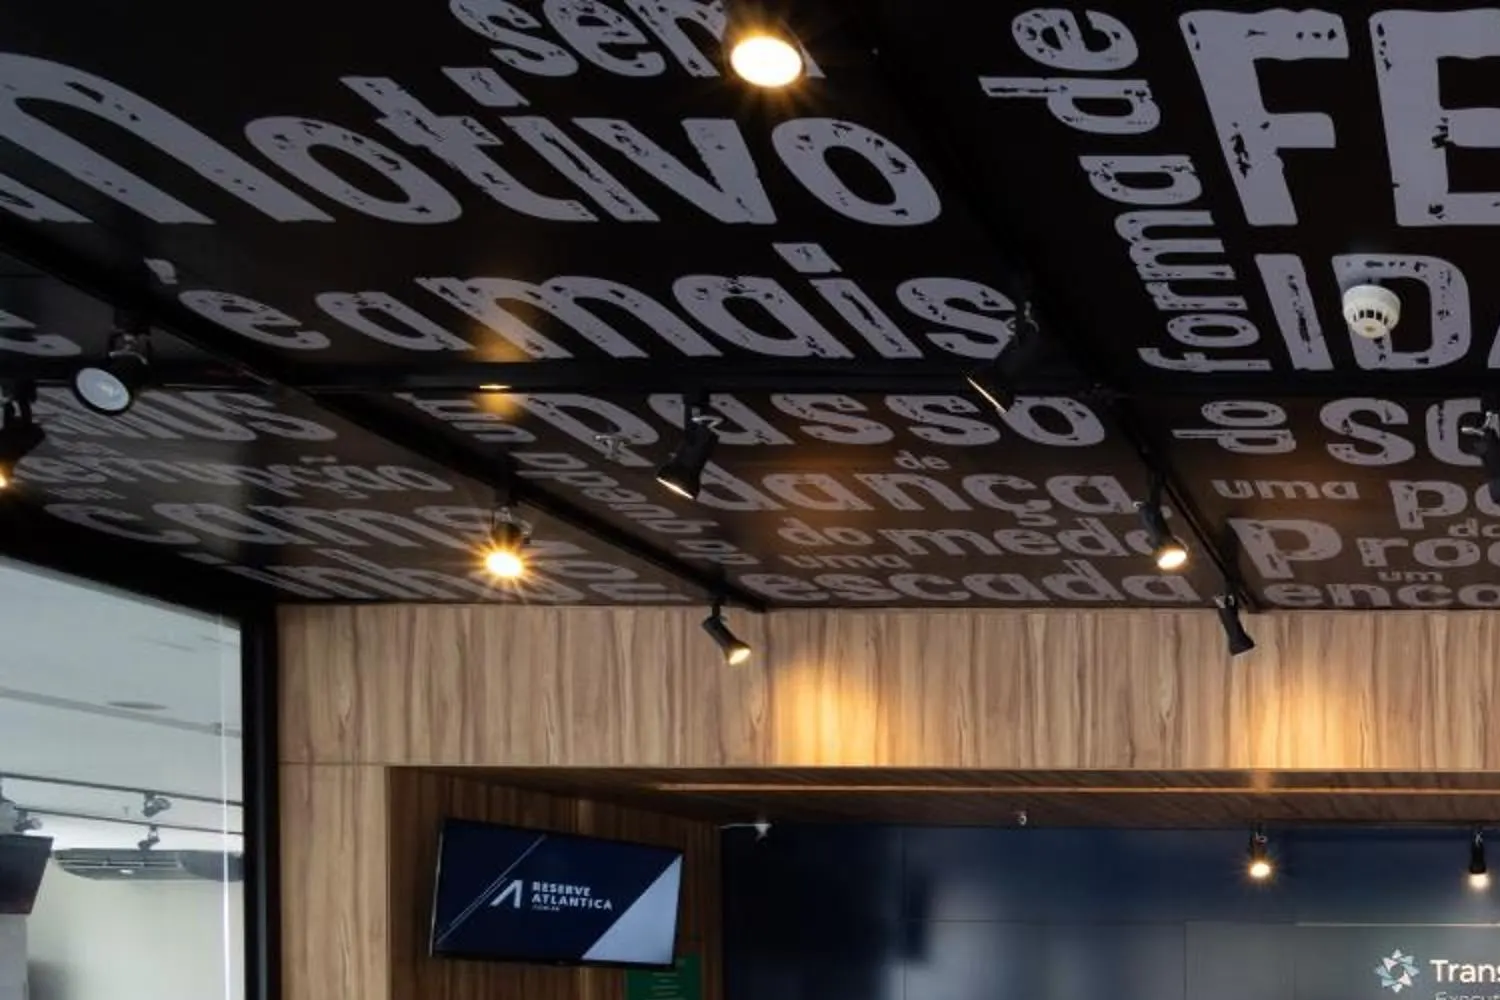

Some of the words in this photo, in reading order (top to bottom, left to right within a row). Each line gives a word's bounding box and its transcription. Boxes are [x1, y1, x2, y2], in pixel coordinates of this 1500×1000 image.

[979, 8, 1161, 135] de
[1079, 155, 1273, 373] forma
[520, 393, 1105, 467] passo
[895, 450, 951, 470] de
[1210, 479, 1361, 500] uma
[777, 517, 873, 546] do
[780, 554, 912, 570] uma
[737, 559, 1201, 602] escada
[1377, 571, 1443, 582] um
[532, 881, 591, 897] RESERVE
[532, 894, 613, 911] ATLANTICA
